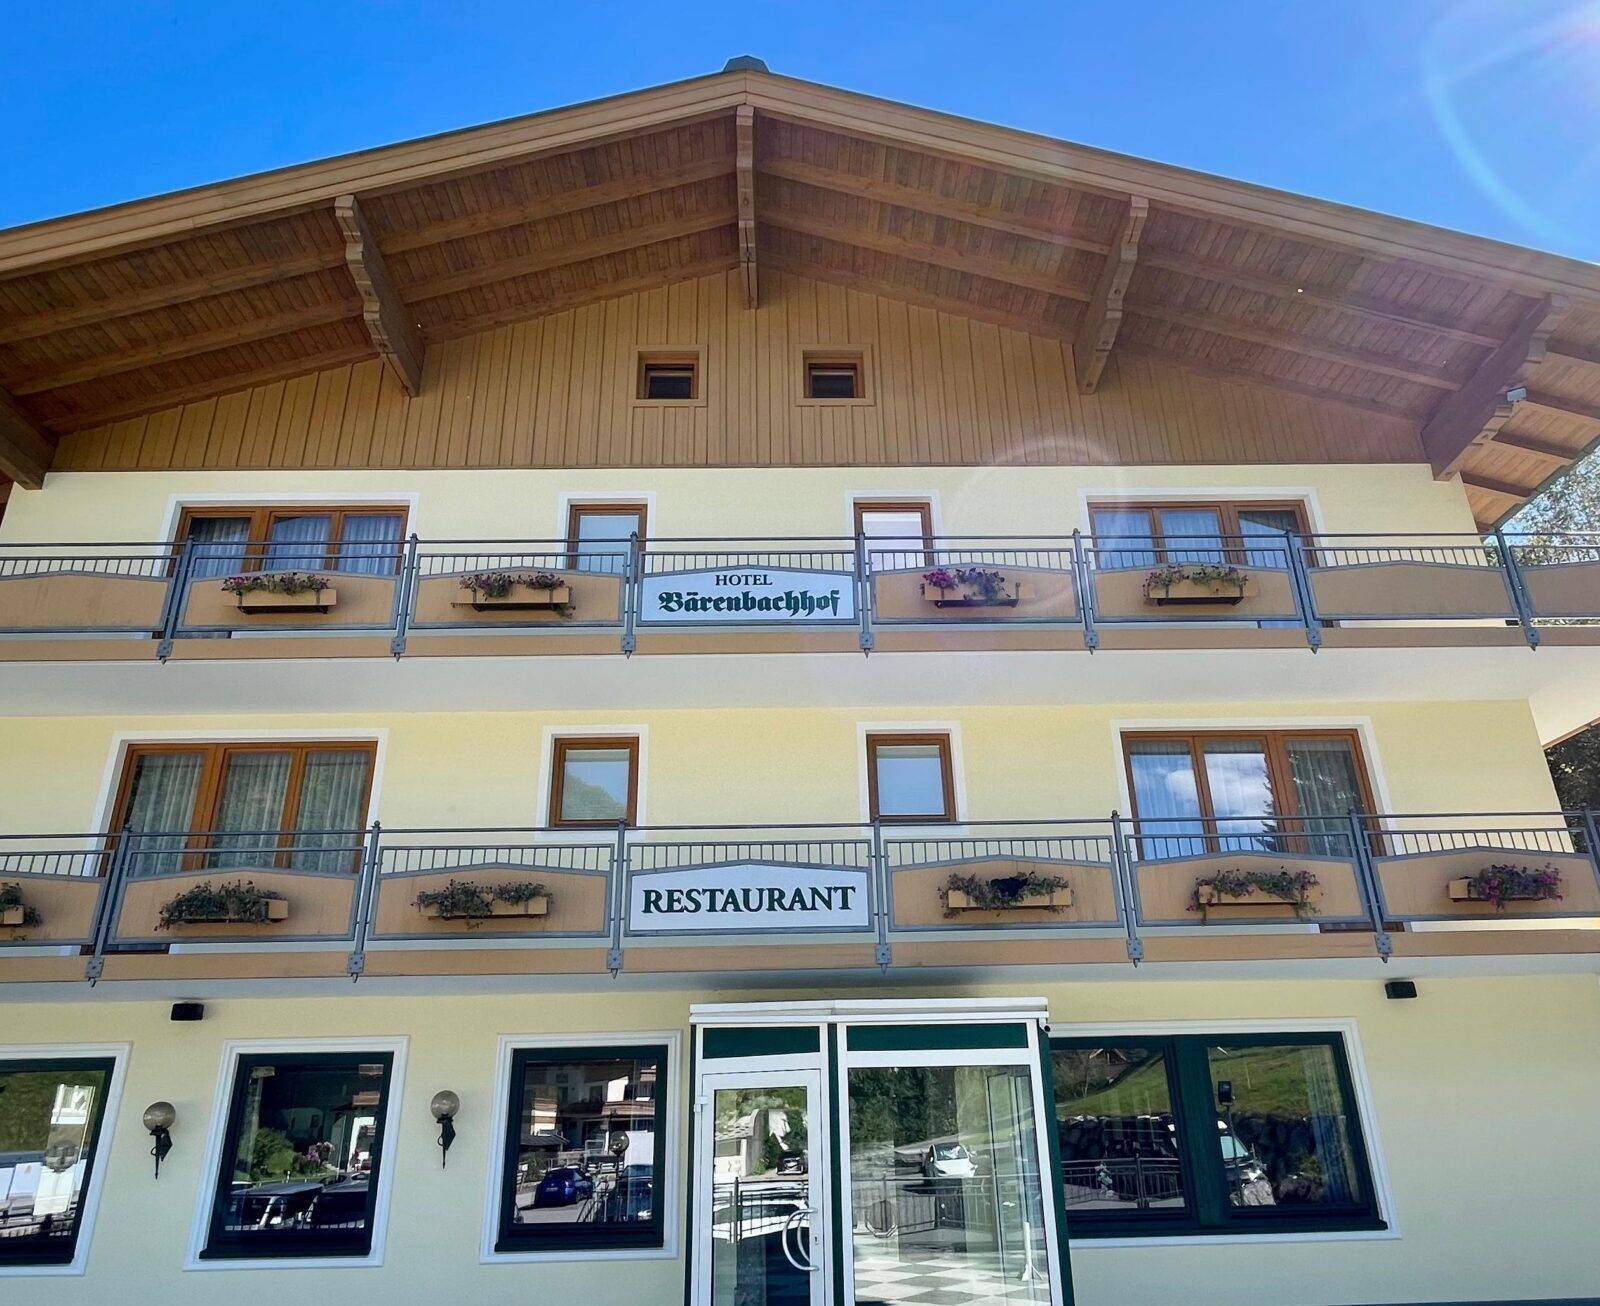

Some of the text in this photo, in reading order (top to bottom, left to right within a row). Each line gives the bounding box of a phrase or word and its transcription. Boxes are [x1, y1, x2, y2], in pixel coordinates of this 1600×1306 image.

[715, 574, 773, 586] HOTEL
[658, 589, 841, 617] Bärenbachhof
[641, 886, 856, 914] RESTAURANT
